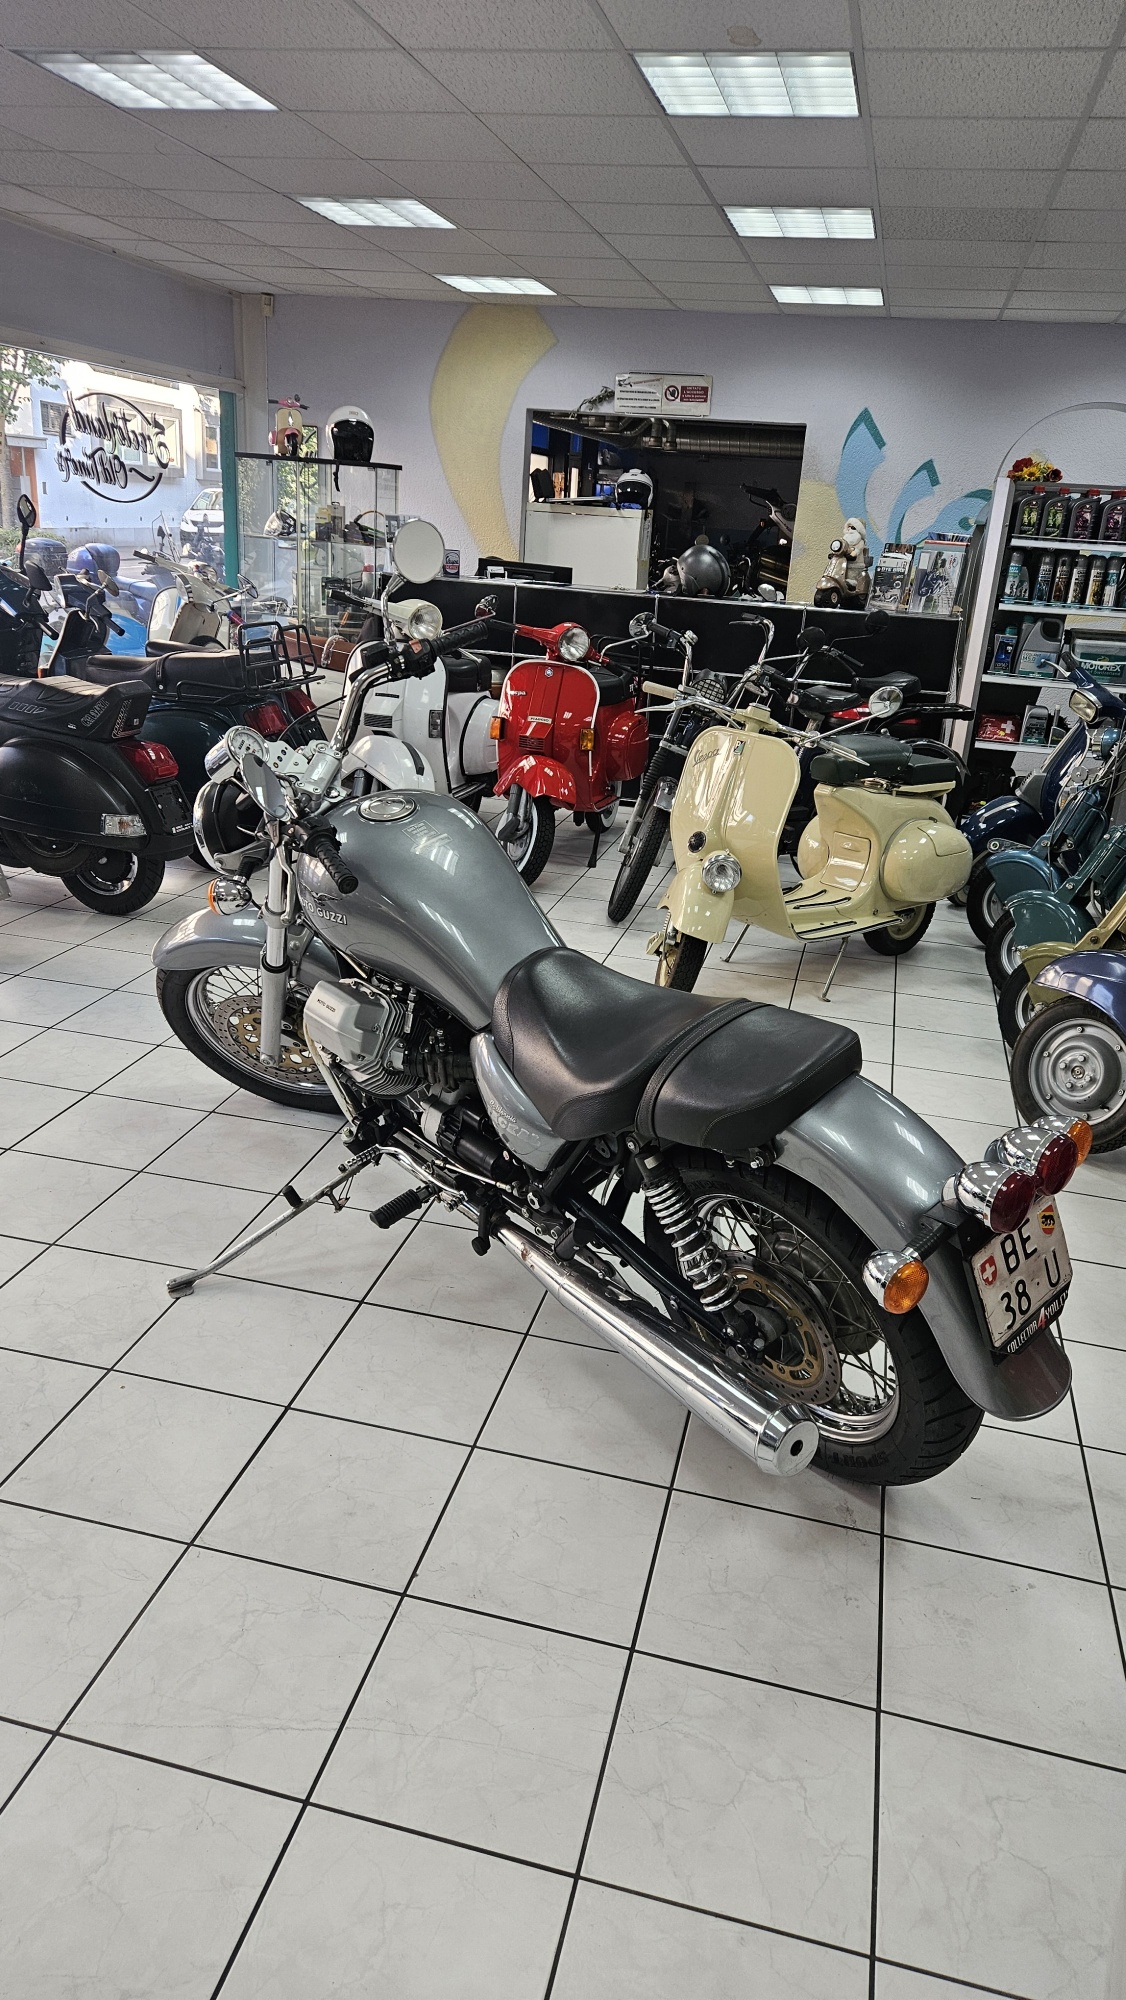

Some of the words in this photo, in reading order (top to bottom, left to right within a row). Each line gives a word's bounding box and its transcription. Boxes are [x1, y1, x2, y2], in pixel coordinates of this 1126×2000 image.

[1081, 662, 1121, 672] MOTOREX
[693, 748, 721, 767] Vespa
[316, 906, 348, 926] GUZZI
[1000, 1217, 1038, 1276] BE
[1000, 1279, 1032, 1330] 38
[1043, 1248, 1062, 1288] U
